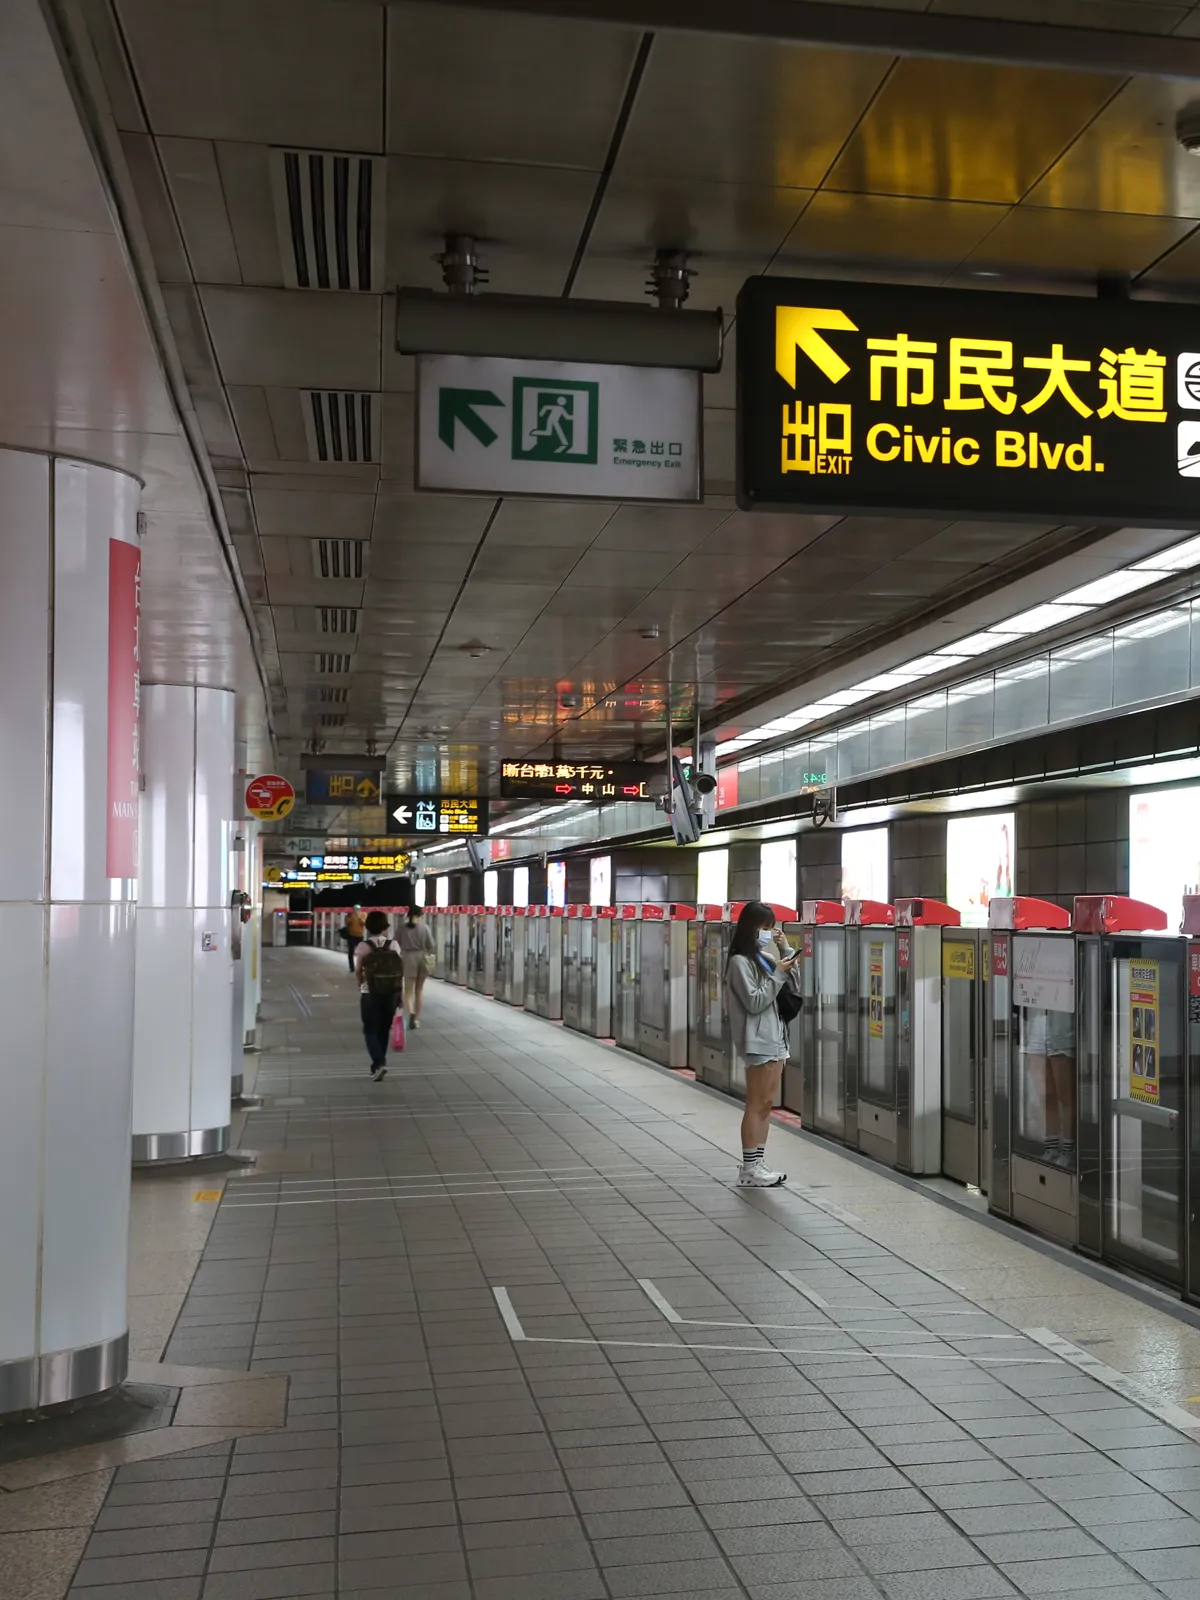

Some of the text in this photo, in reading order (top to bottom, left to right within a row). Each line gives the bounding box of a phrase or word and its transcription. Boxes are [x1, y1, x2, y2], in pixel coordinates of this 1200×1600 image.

[866, 333, 1168, 423] 市民大道
[612, 438, 683, 457] 緊急出口
[781, 400, 852, 475] 出口
[866, 423, 1105, 473] Civic Blvd.
[613, 457, 682, 468] Emergency Exit
[816, 454, 853, 475] EXIT
[329, 775, 355, 797] 出口
